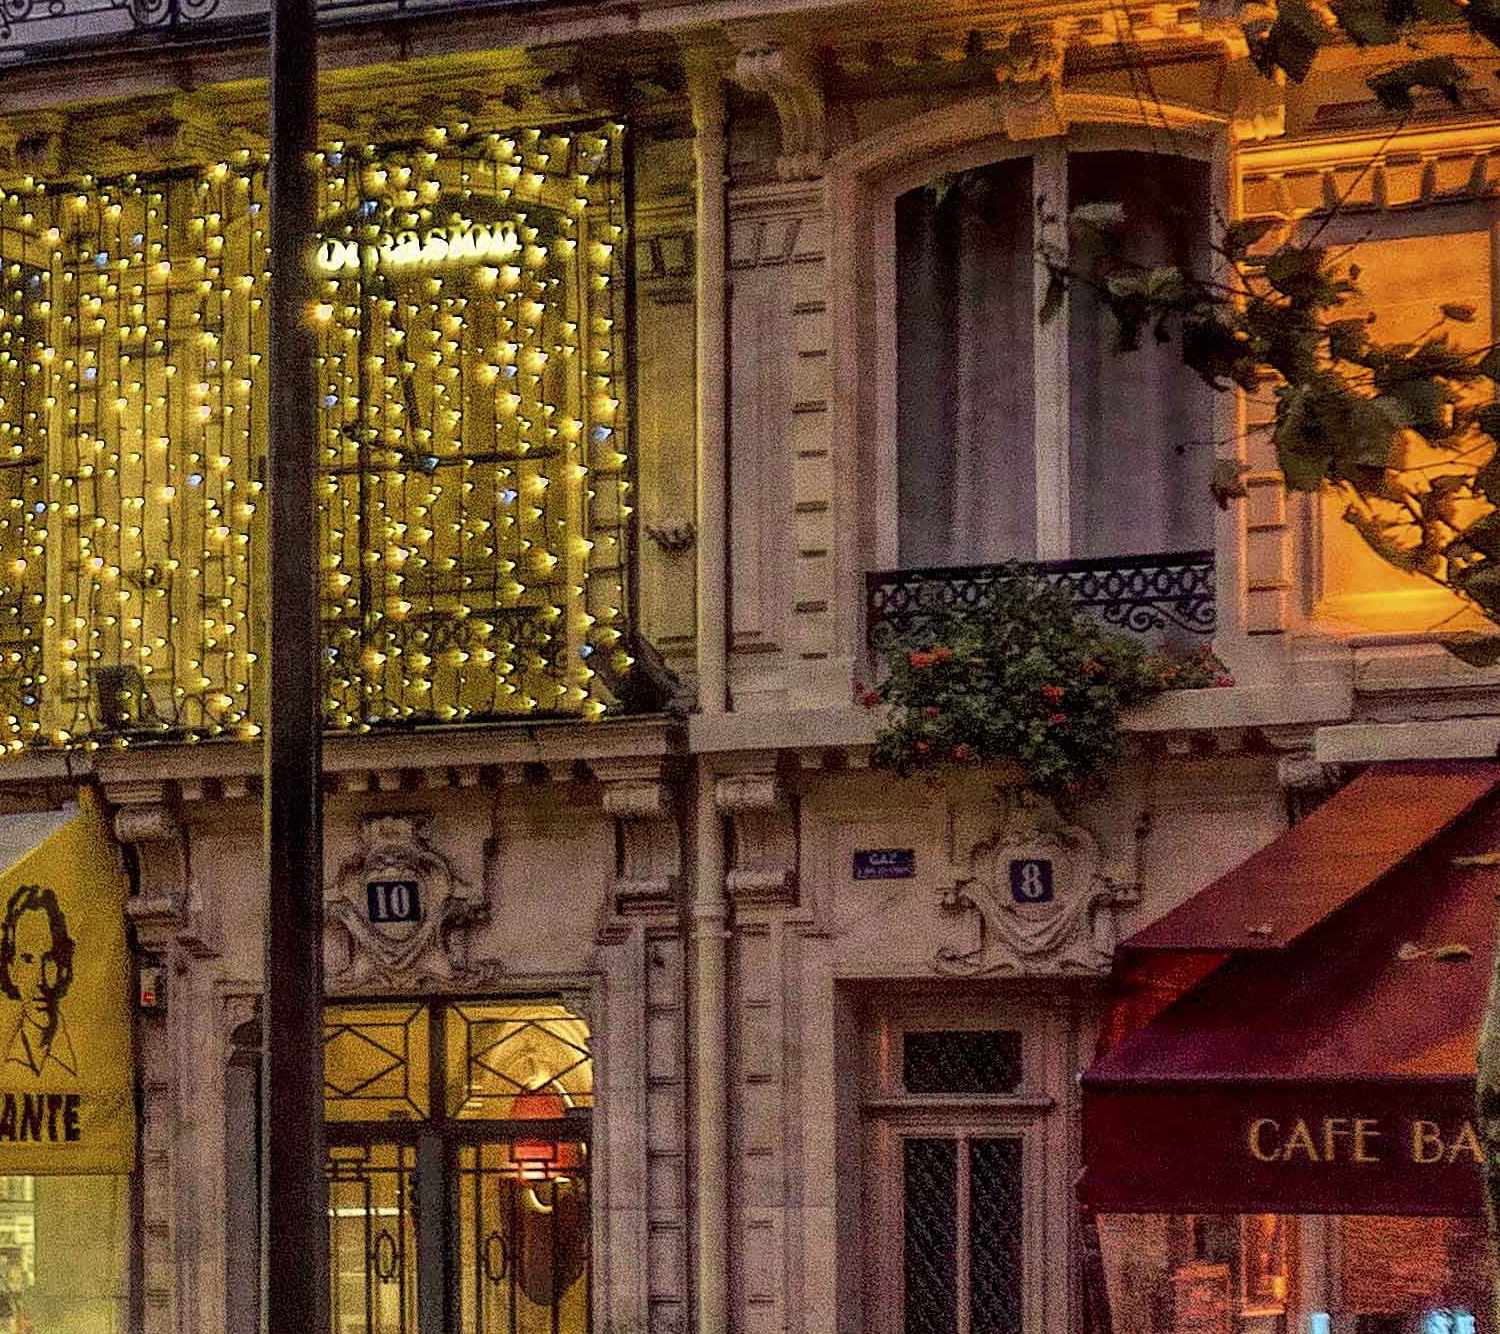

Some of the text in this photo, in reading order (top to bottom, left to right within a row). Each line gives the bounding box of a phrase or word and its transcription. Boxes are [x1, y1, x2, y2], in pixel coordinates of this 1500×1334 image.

[1021, 863, 1043, 898] 8
[376, 885, 410, 918] 10
[1249, 1117, 1487, 1164] CAFE BA
